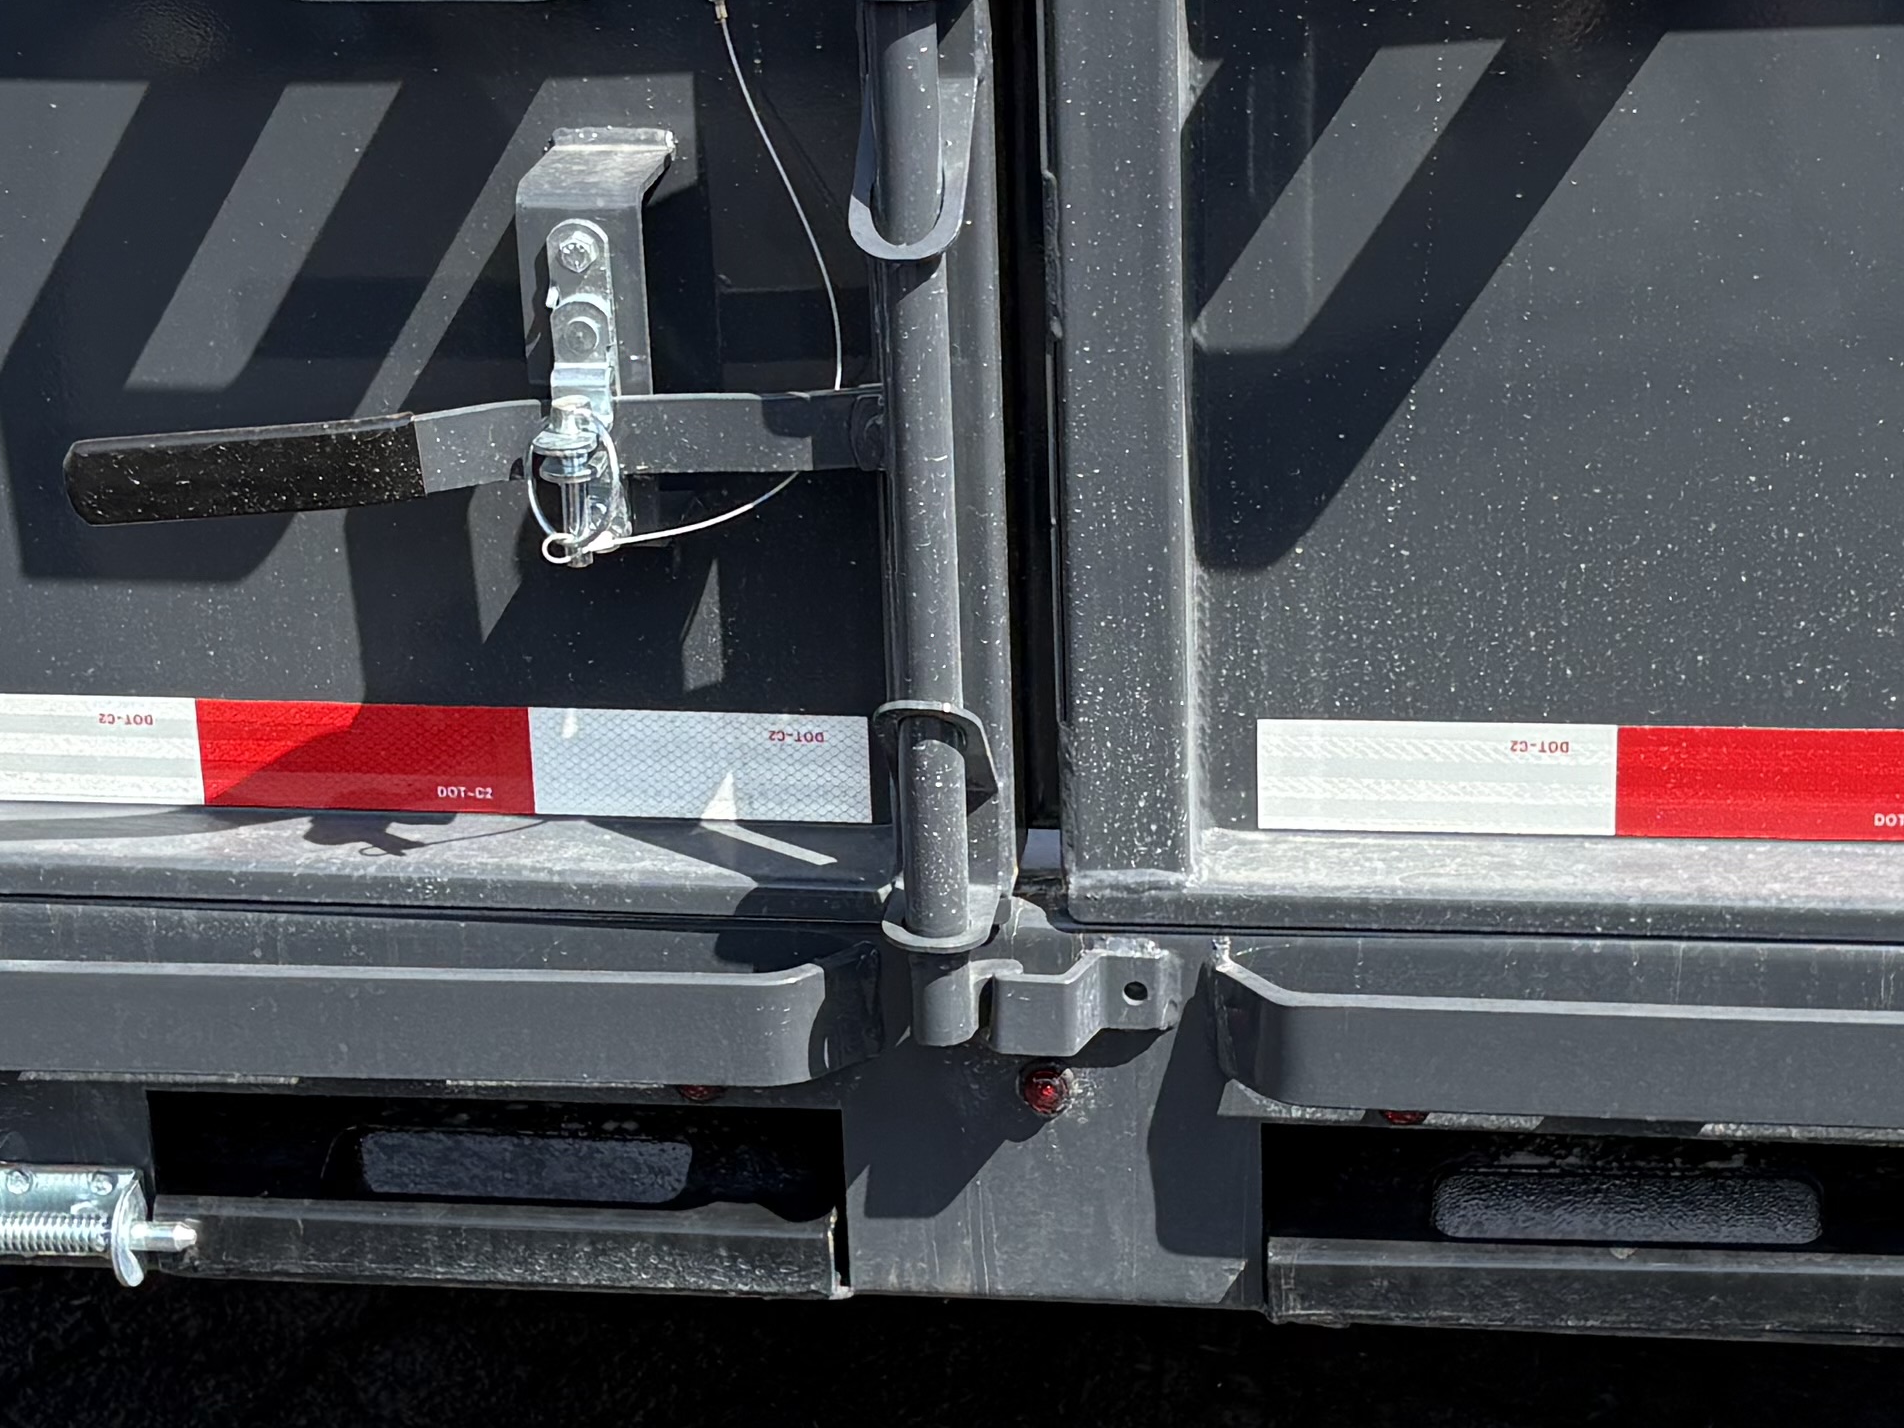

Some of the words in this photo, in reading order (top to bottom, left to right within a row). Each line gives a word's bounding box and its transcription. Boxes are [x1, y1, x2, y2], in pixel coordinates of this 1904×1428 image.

[98, 713, 154, 726] DOT-C2
[767, 730, 825, 743] DOT-C2
[1509, 740, 1570, 754] DOT-C2
[437, 785, 494, 800] DOT-C2
